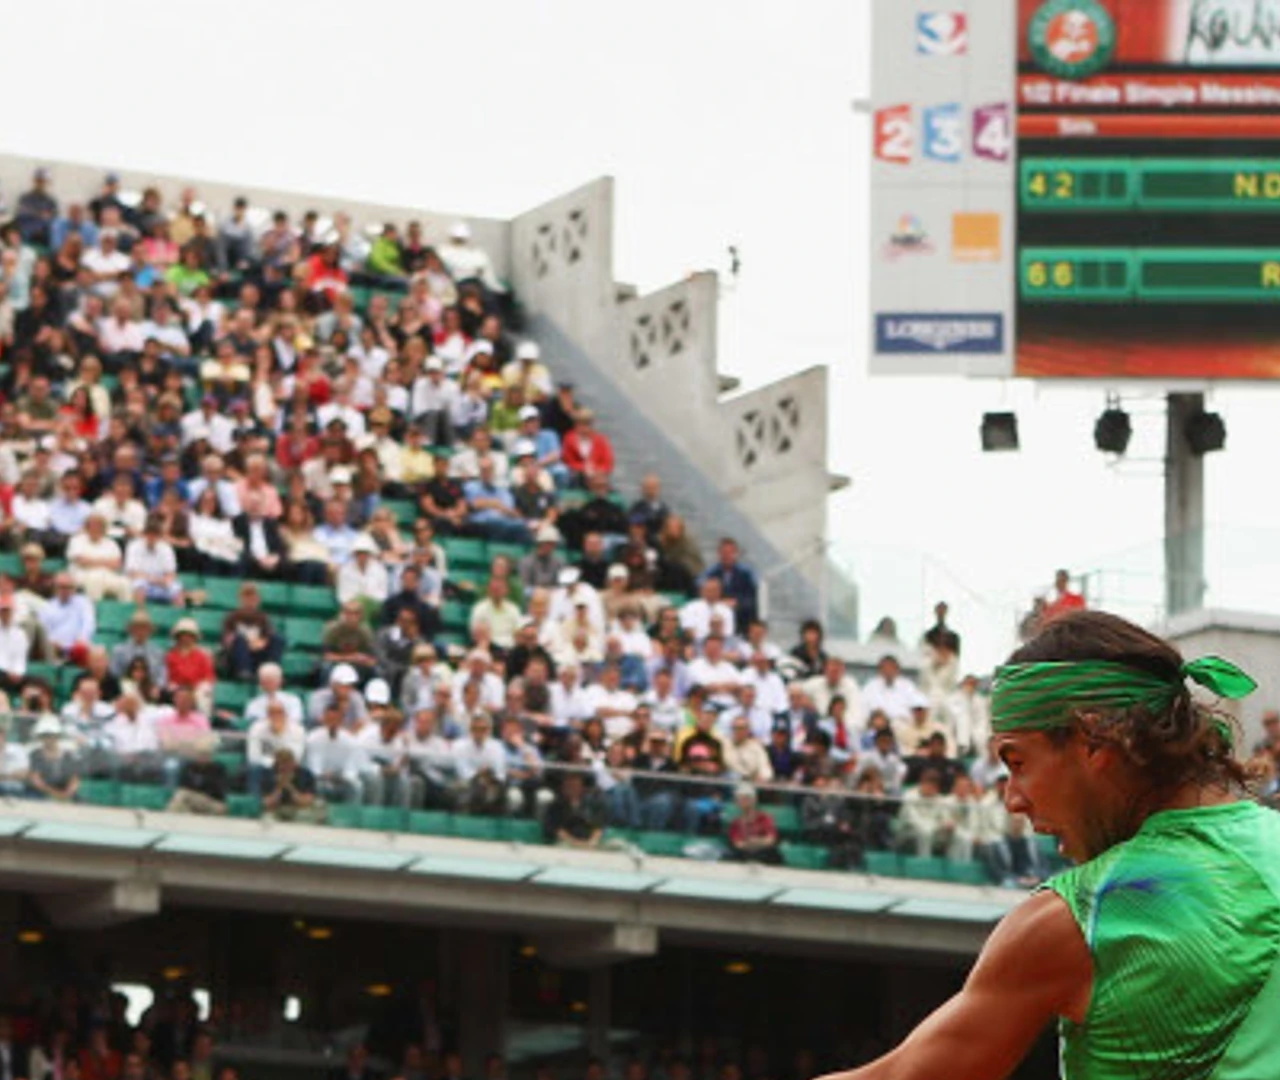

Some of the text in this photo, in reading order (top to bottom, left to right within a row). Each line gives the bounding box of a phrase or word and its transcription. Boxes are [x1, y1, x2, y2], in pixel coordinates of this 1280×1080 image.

[1056, 82, 1120, 104] Finale
[1125, 82, 1196, 106] Simple
[1028, 172, 1073, 197] 4 2
[1027, 261, 1074, 287] 6 6
